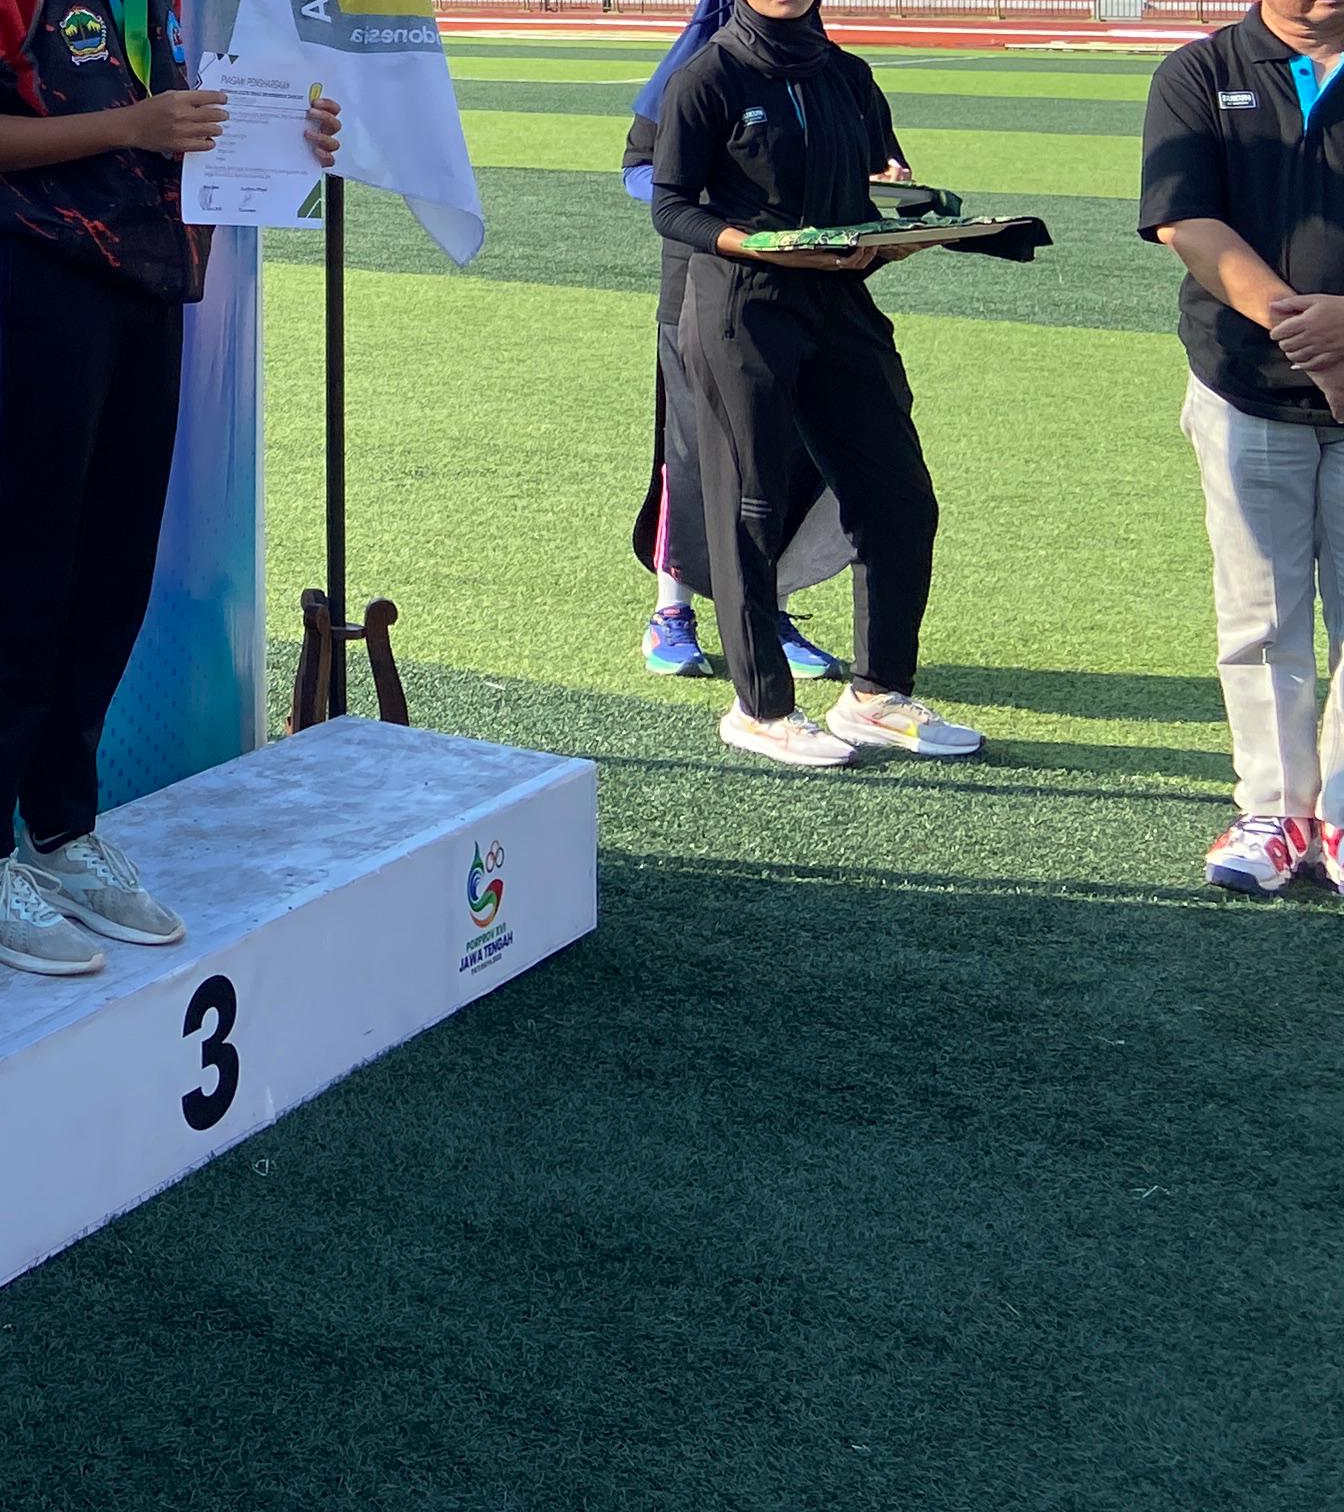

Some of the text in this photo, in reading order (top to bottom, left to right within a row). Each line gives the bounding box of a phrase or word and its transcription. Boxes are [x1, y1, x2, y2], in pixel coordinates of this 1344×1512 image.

[459, 949, 483, 973] JAWA
[484, 930, 513, 958] TENGAH
[180, 973, 241, 1133] 3
